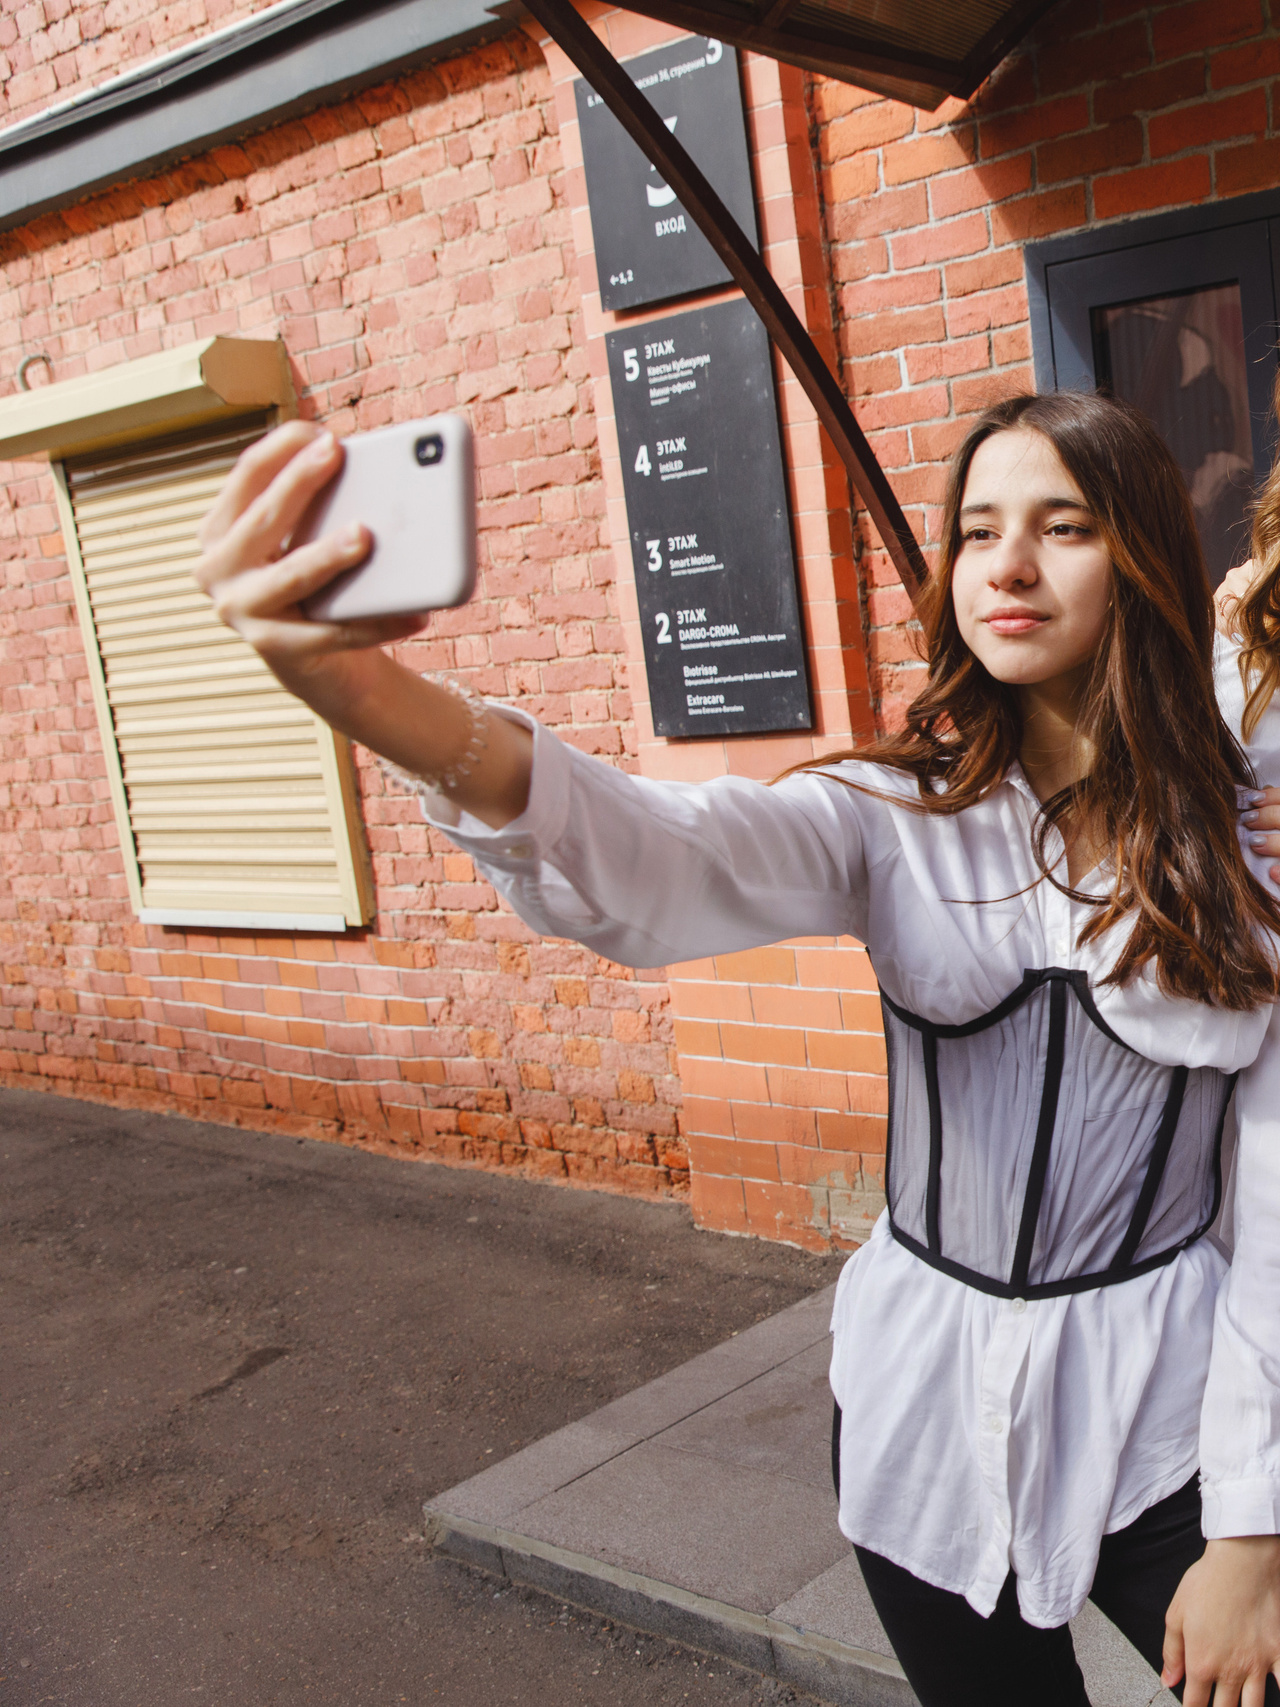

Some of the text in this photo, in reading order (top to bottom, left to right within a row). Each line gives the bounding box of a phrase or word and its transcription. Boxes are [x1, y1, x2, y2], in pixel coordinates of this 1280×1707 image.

[669, 57, 705, 78] строение
[655, 215, 687, 237] ВХОД
[623, 348, 640, 382] 5
[644, 339, 675, 359] ЭТАЖ
[647, 363, 672, 377] Квесты
[672, 354, 711, 372] Кубикулум
[649, 380, 697, 398] Мини-офисы
[634, 445, 652, 476] 4
[656, 436, 687, 456] ЭТАЖ
[646, 539, 663, 572] 3
[667, 533, 698, 552] ЭТАЖ
[670, 554, 716, 569] Smart Motion
[655, 608, 707, 645] 2 ЭТАЖ
[679, 624, 739, 641] DARGO-CROMA
[686, 694, 725, 706] Extracare
